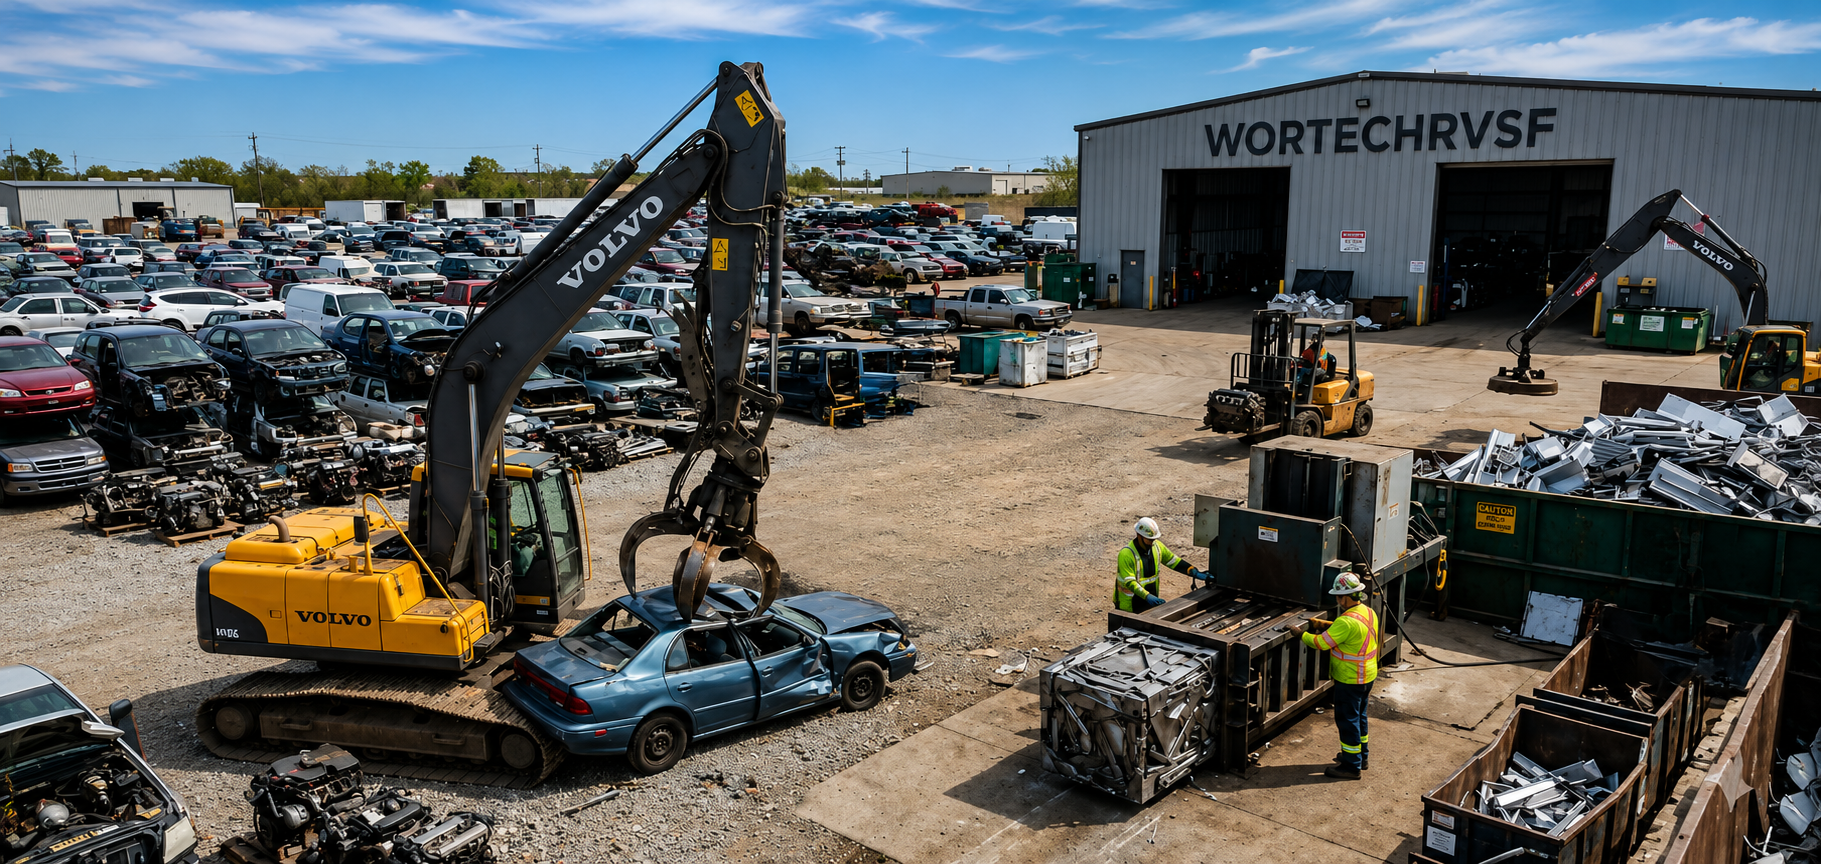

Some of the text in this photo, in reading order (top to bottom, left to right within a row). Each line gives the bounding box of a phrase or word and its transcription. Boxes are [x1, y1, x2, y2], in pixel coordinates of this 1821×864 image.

[1204, 107, 1557, 157] WORTECHRVSF
[556, 195, 664, 289] VOLVO
[1692, 240, 1734, 271] VOLVO
[294, 610, 372, 627] VOLVO
